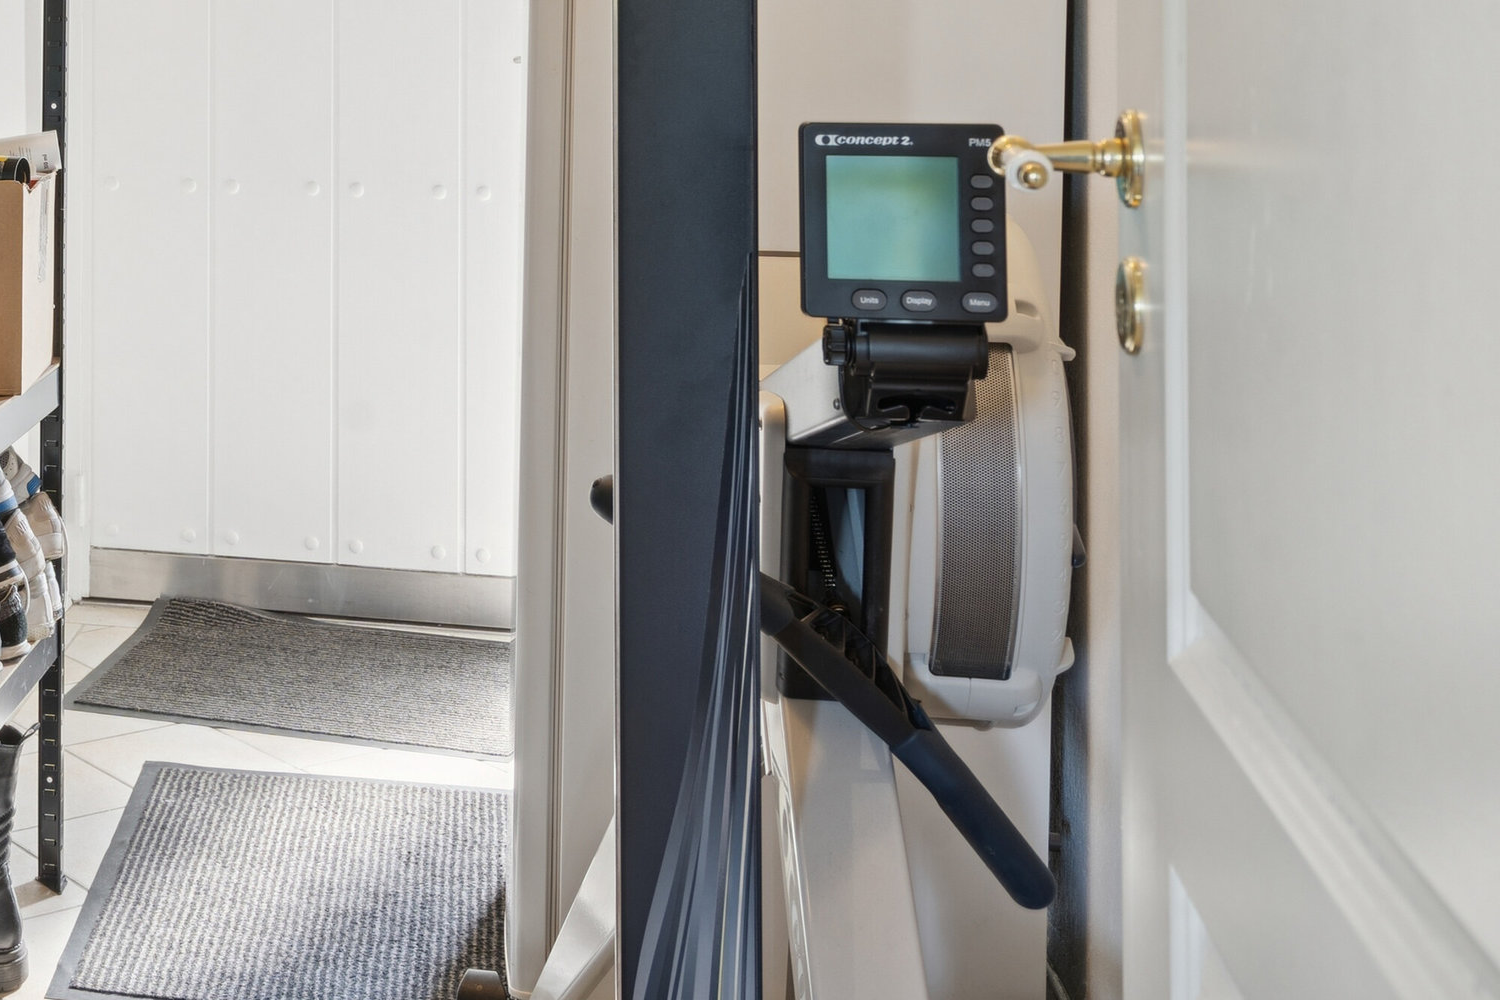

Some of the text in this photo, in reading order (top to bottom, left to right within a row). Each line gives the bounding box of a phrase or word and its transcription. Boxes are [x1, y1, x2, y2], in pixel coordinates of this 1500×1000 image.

[837, 134, 899, 146] concept
[968, 137, 992, 147] PM5
[860, 296, 879, 304] Units
[906, 296, 933, 306] Display
[969, 299, 991, 307] Menu
